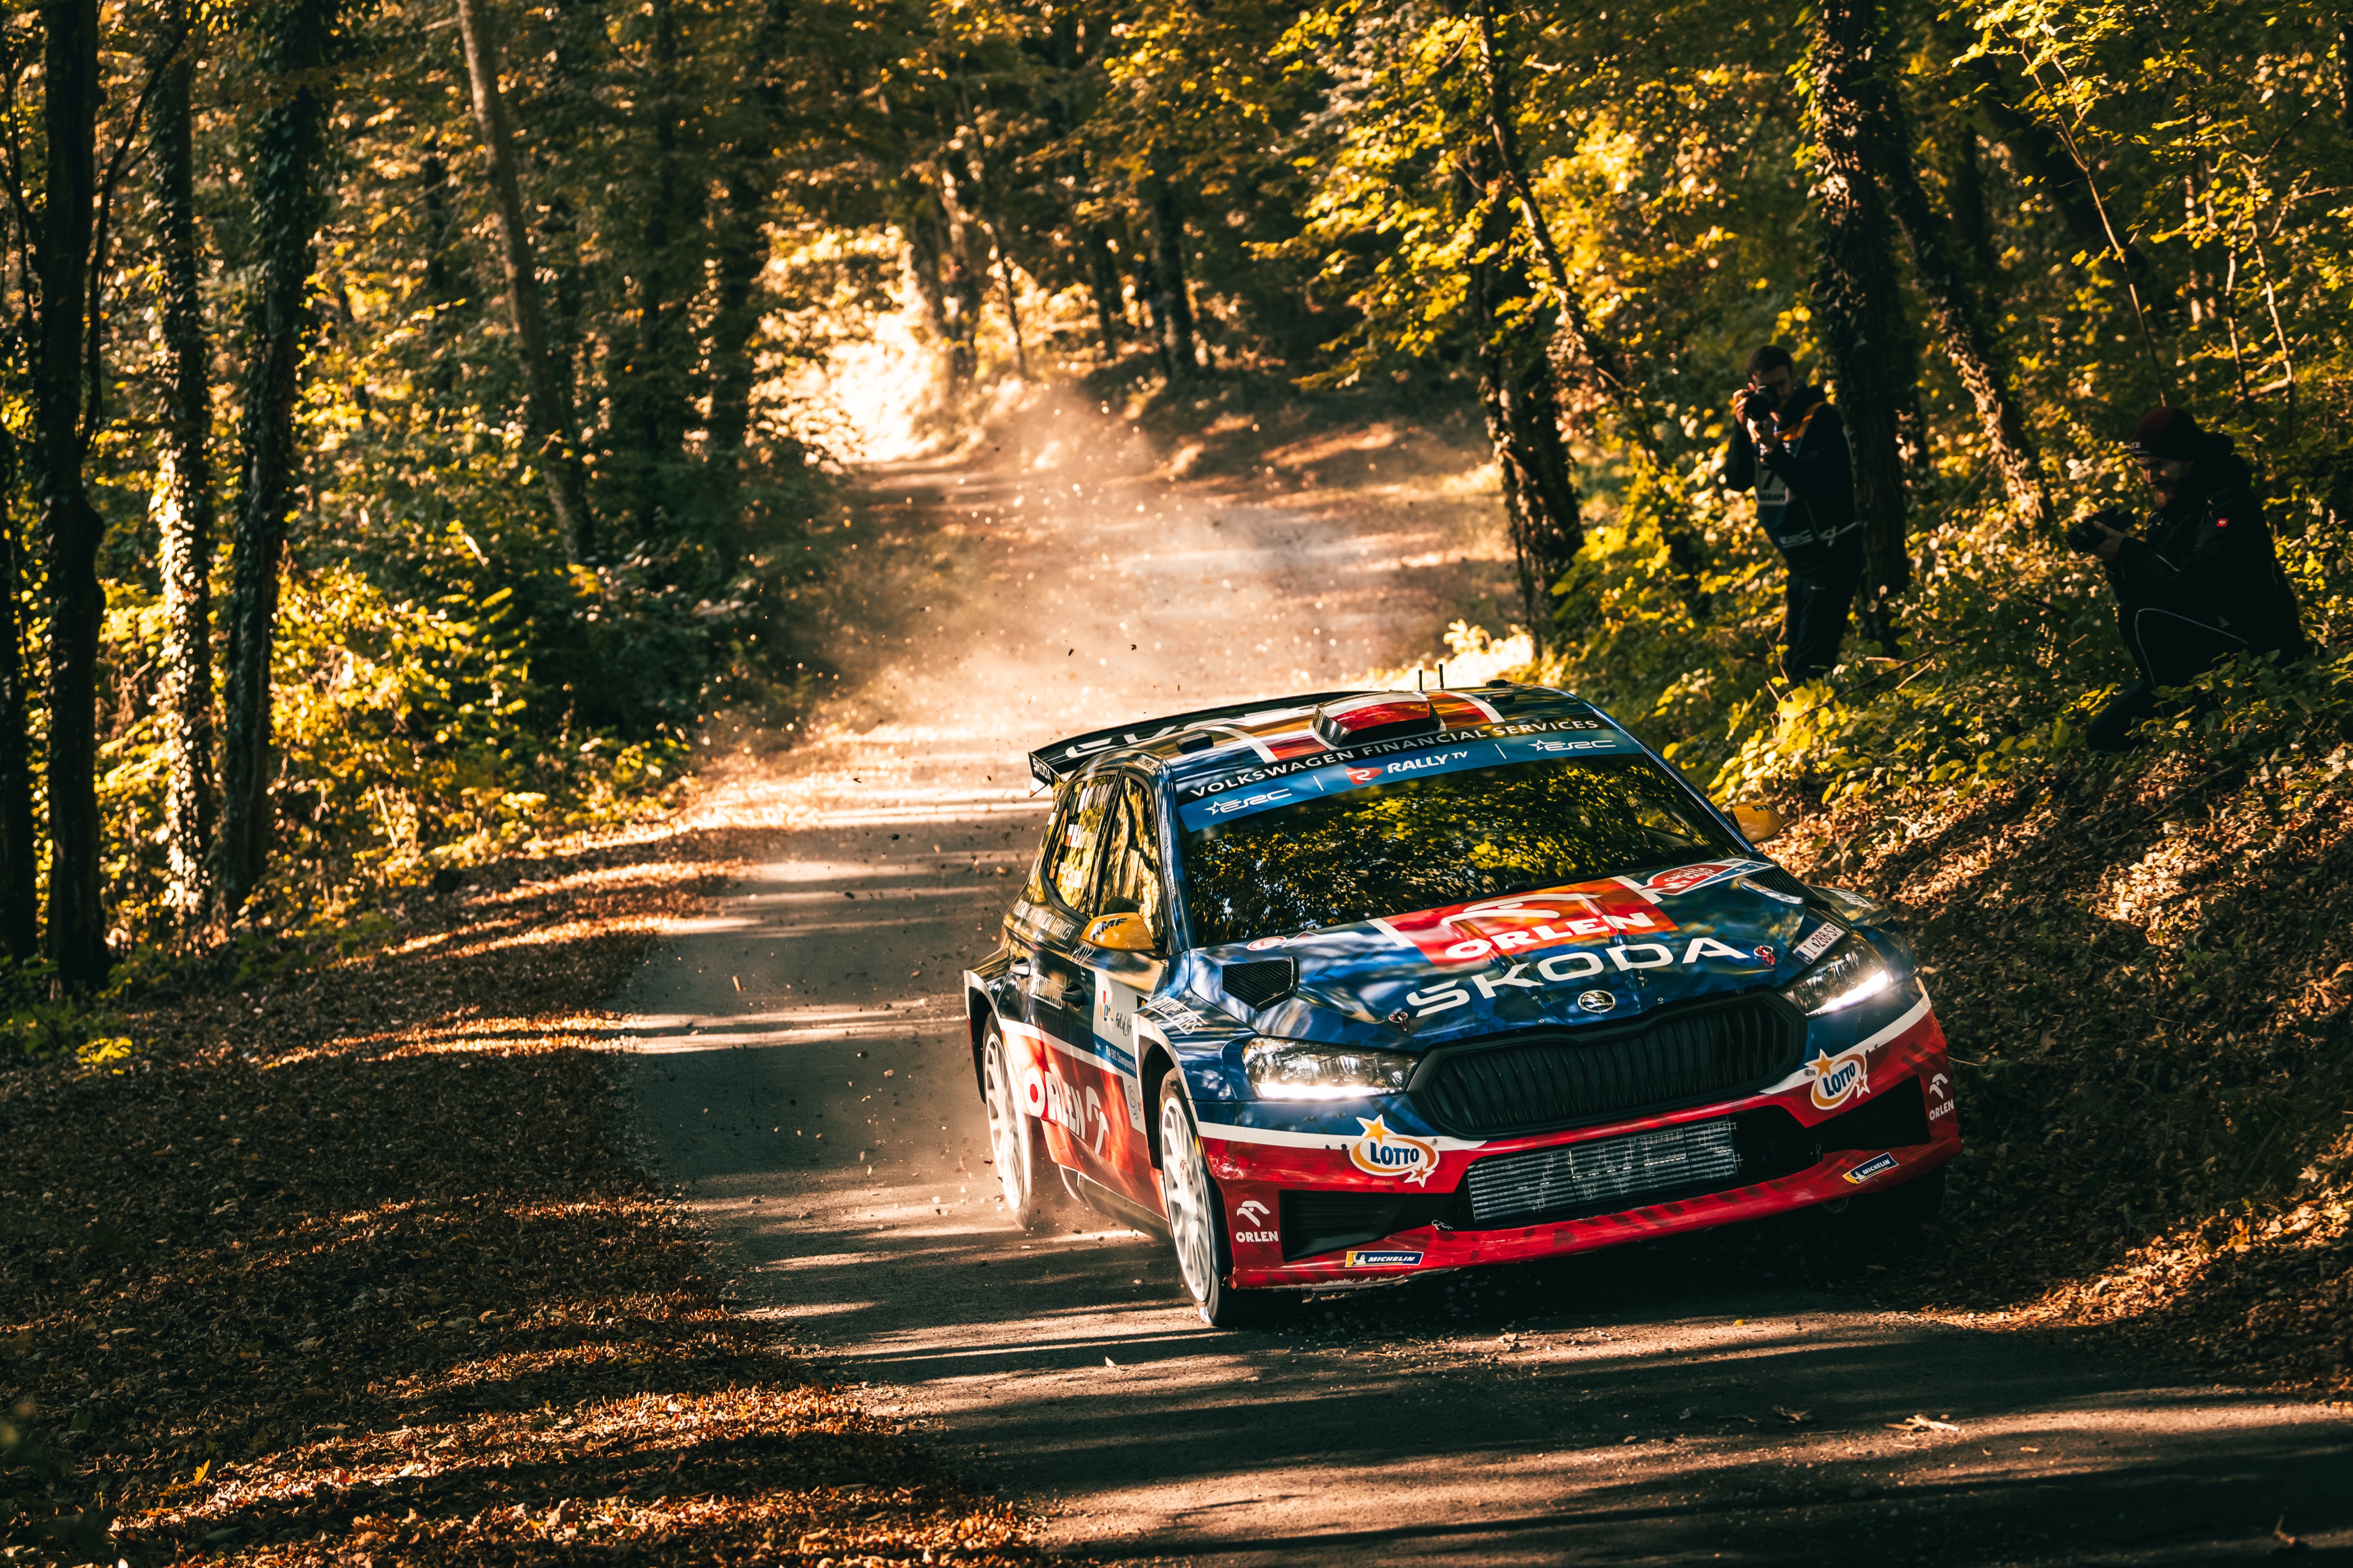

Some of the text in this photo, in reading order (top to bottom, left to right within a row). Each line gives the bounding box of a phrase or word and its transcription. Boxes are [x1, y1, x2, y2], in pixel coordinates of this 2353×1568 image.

[1190, 720, 1599, 797] VOLKSWAGEN FINANCIAL SERVICES
[1048, 917, 1075, 940] SERVICES
[1445, 912, 1656, 959] ORLEN
[1406, 937, 1750, 1017] SKODA
[1822, 1062, 1856, 1097] LOTTO
[1024, 1067, 1086, 1140] ORLEN
[1929, 1099, 1954, 1121] ORLEN
[1370, 1141, 1419, 1165] LOTTO
[1862, 1158, 1891, 1175] MICHELIN
[1236, 1231, 1279, 1243] ORLEN
